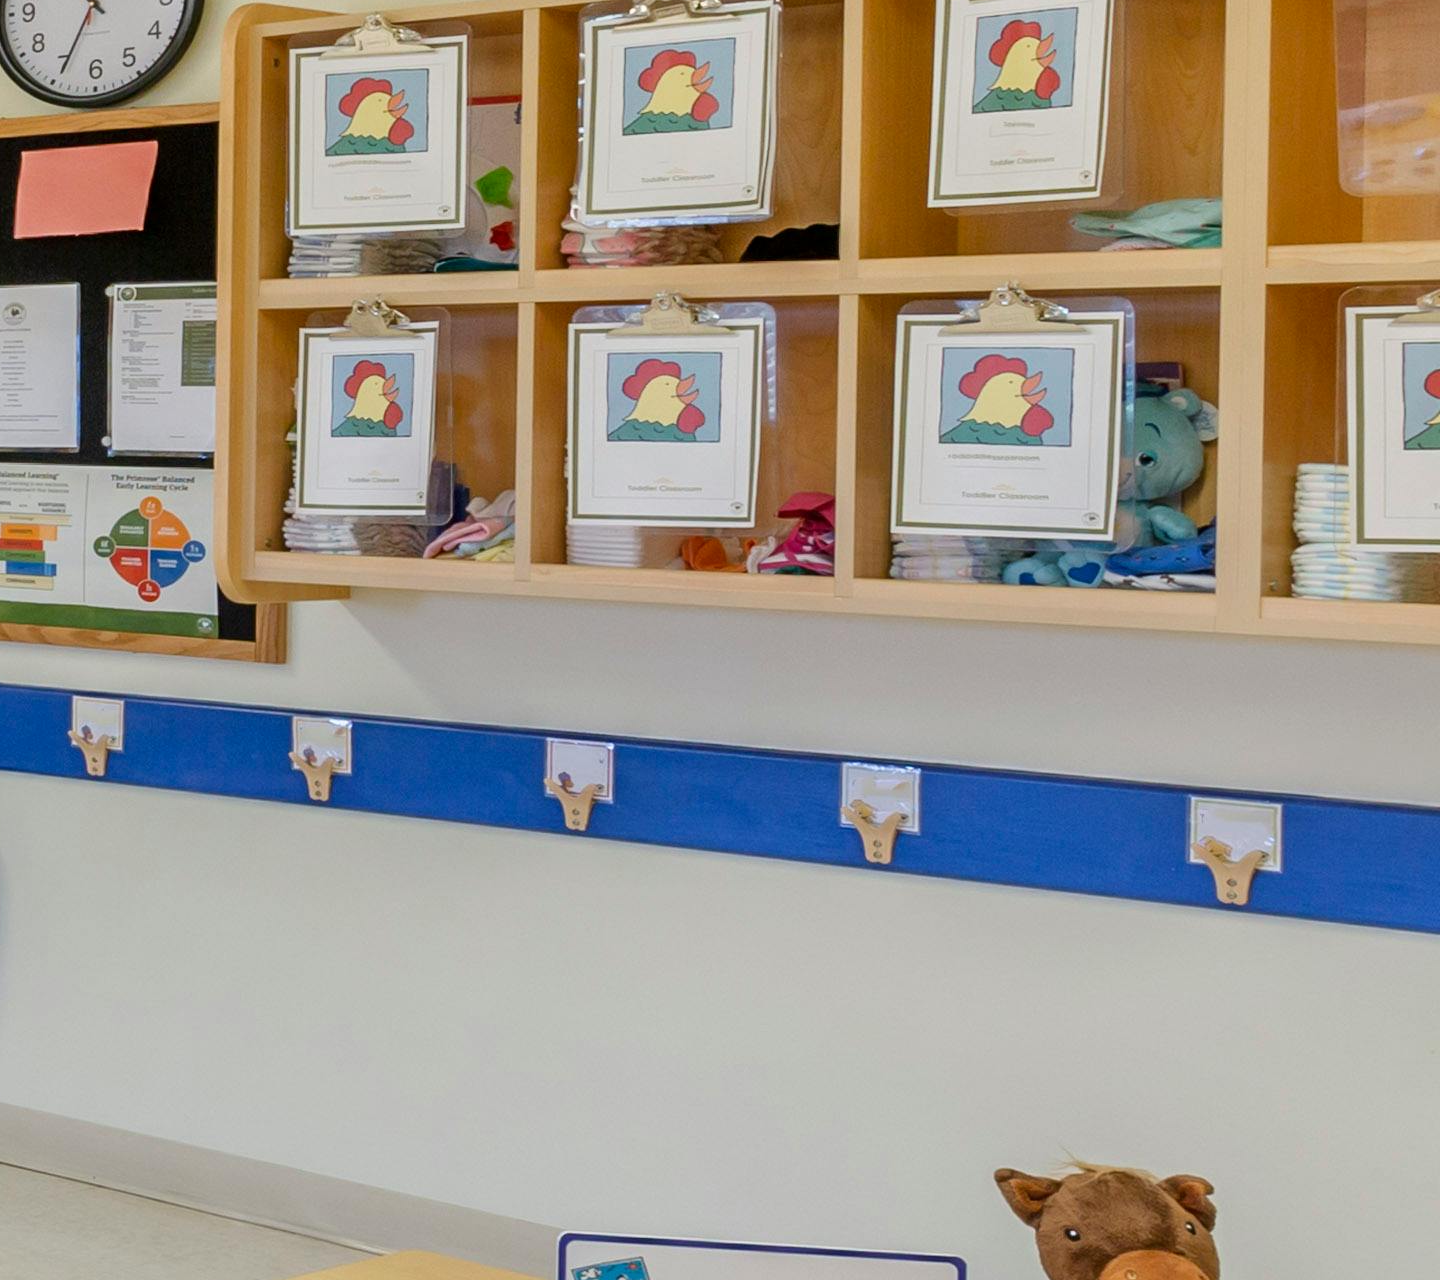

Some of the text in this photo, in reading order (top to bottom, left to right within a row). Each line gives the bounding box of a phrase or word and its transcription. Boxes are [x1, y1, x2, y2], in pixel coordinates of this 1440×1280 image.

[22, 3, 35, 22] 9
[147, 20, 162, 40] 4
[32, 33, 45, 53] 8
[122, 47, 136, 67] 5
[89, 59, 103, 79] 6
[111, 474, 125, 482] The
[136, 483, 168, 492] Learning
